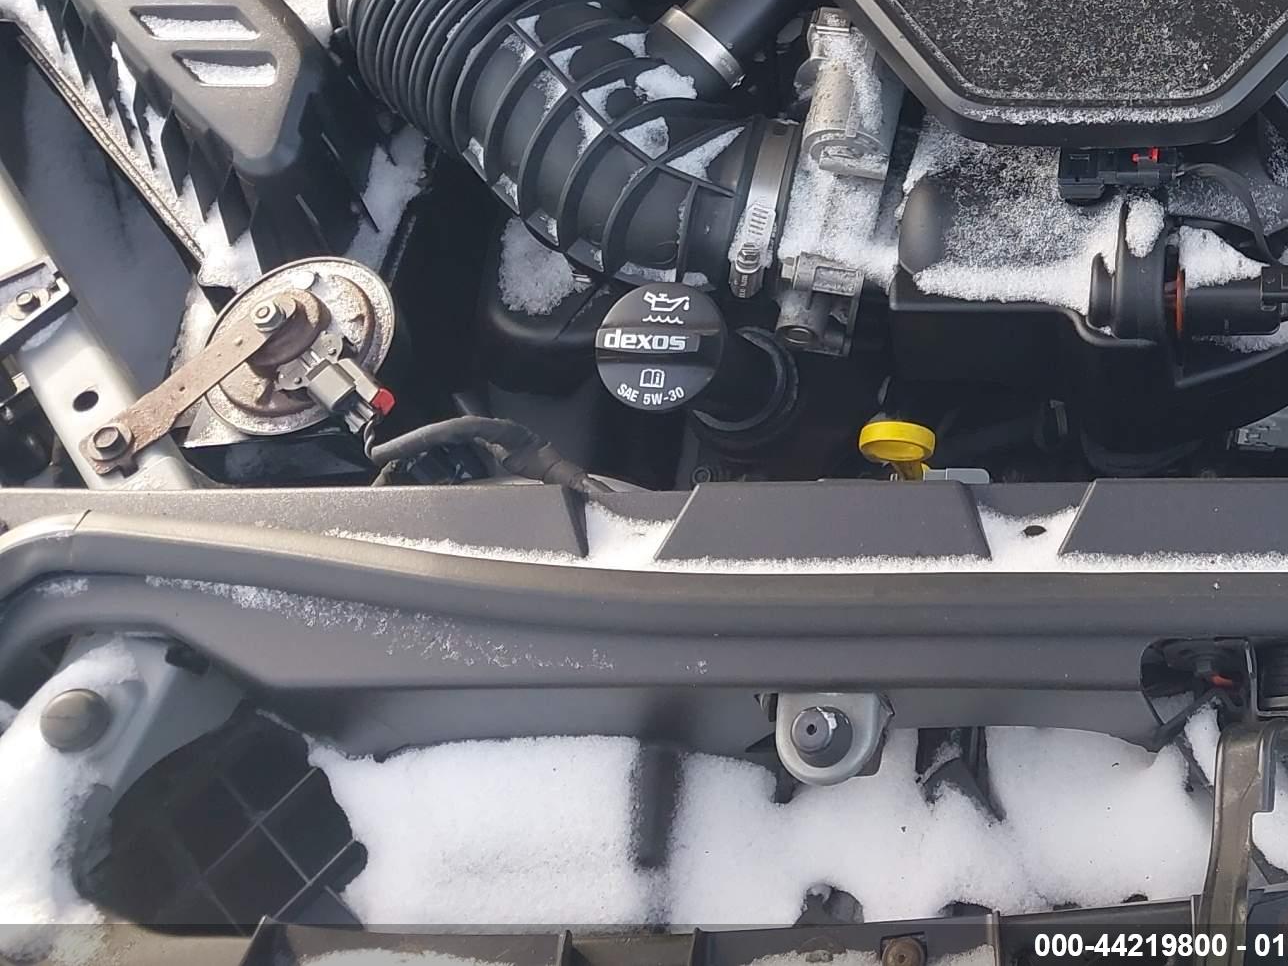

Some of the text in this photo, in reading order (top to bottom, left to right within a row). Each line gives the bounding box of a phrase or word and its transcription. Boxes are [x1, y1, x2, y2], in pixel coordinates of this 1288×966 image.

[604, 329, 688, 350] dexos
[617, 383, 685, 405] SAE 5W-30
